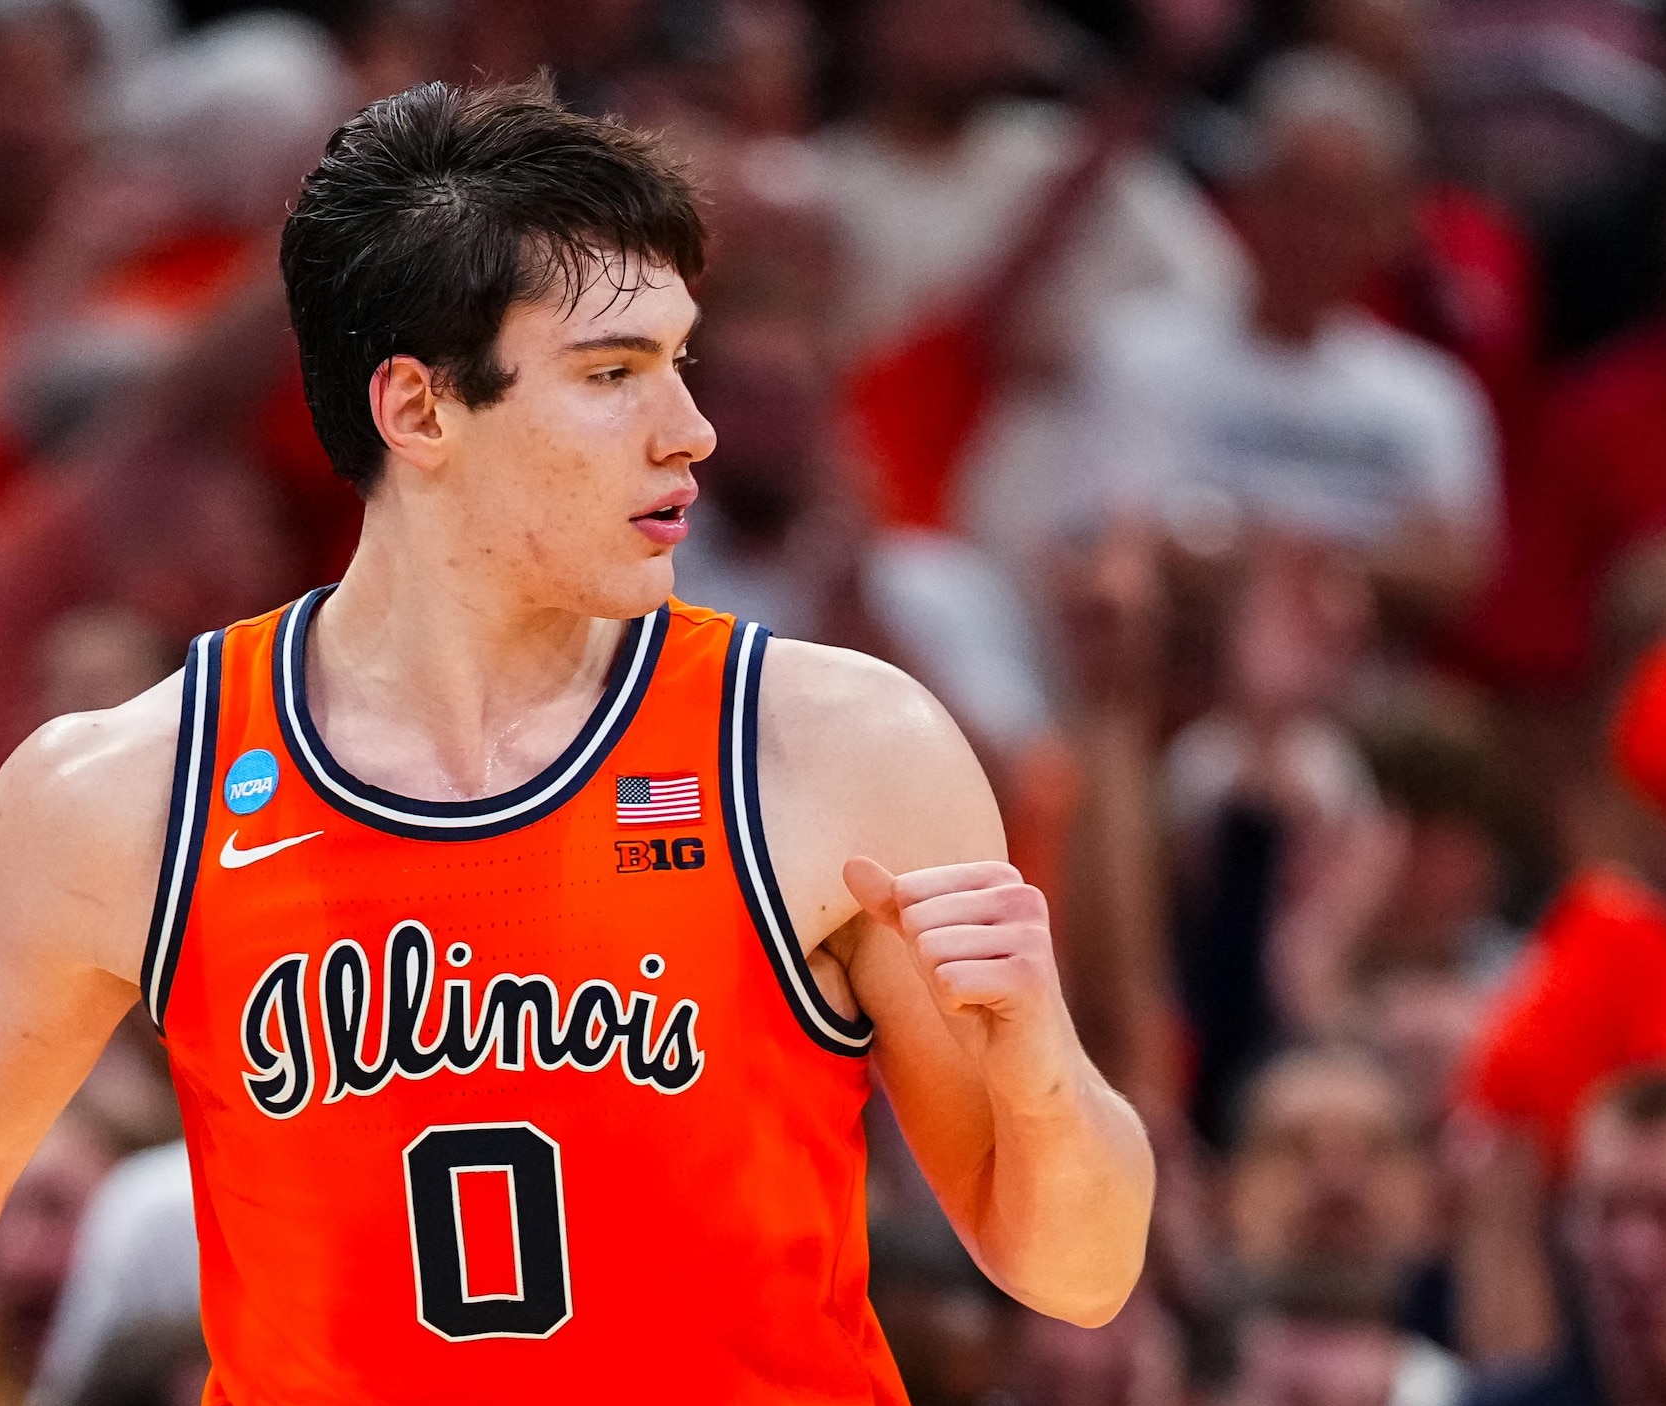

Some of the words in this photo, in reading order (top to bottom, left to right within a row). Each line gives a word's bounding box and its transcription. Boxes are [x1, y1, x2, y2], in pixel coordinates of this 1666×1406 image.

[229, 776, 273, 801] NCAA
[241, 919, 705, 1119] Illinois
[402, 1120, 574, 1343] 0
